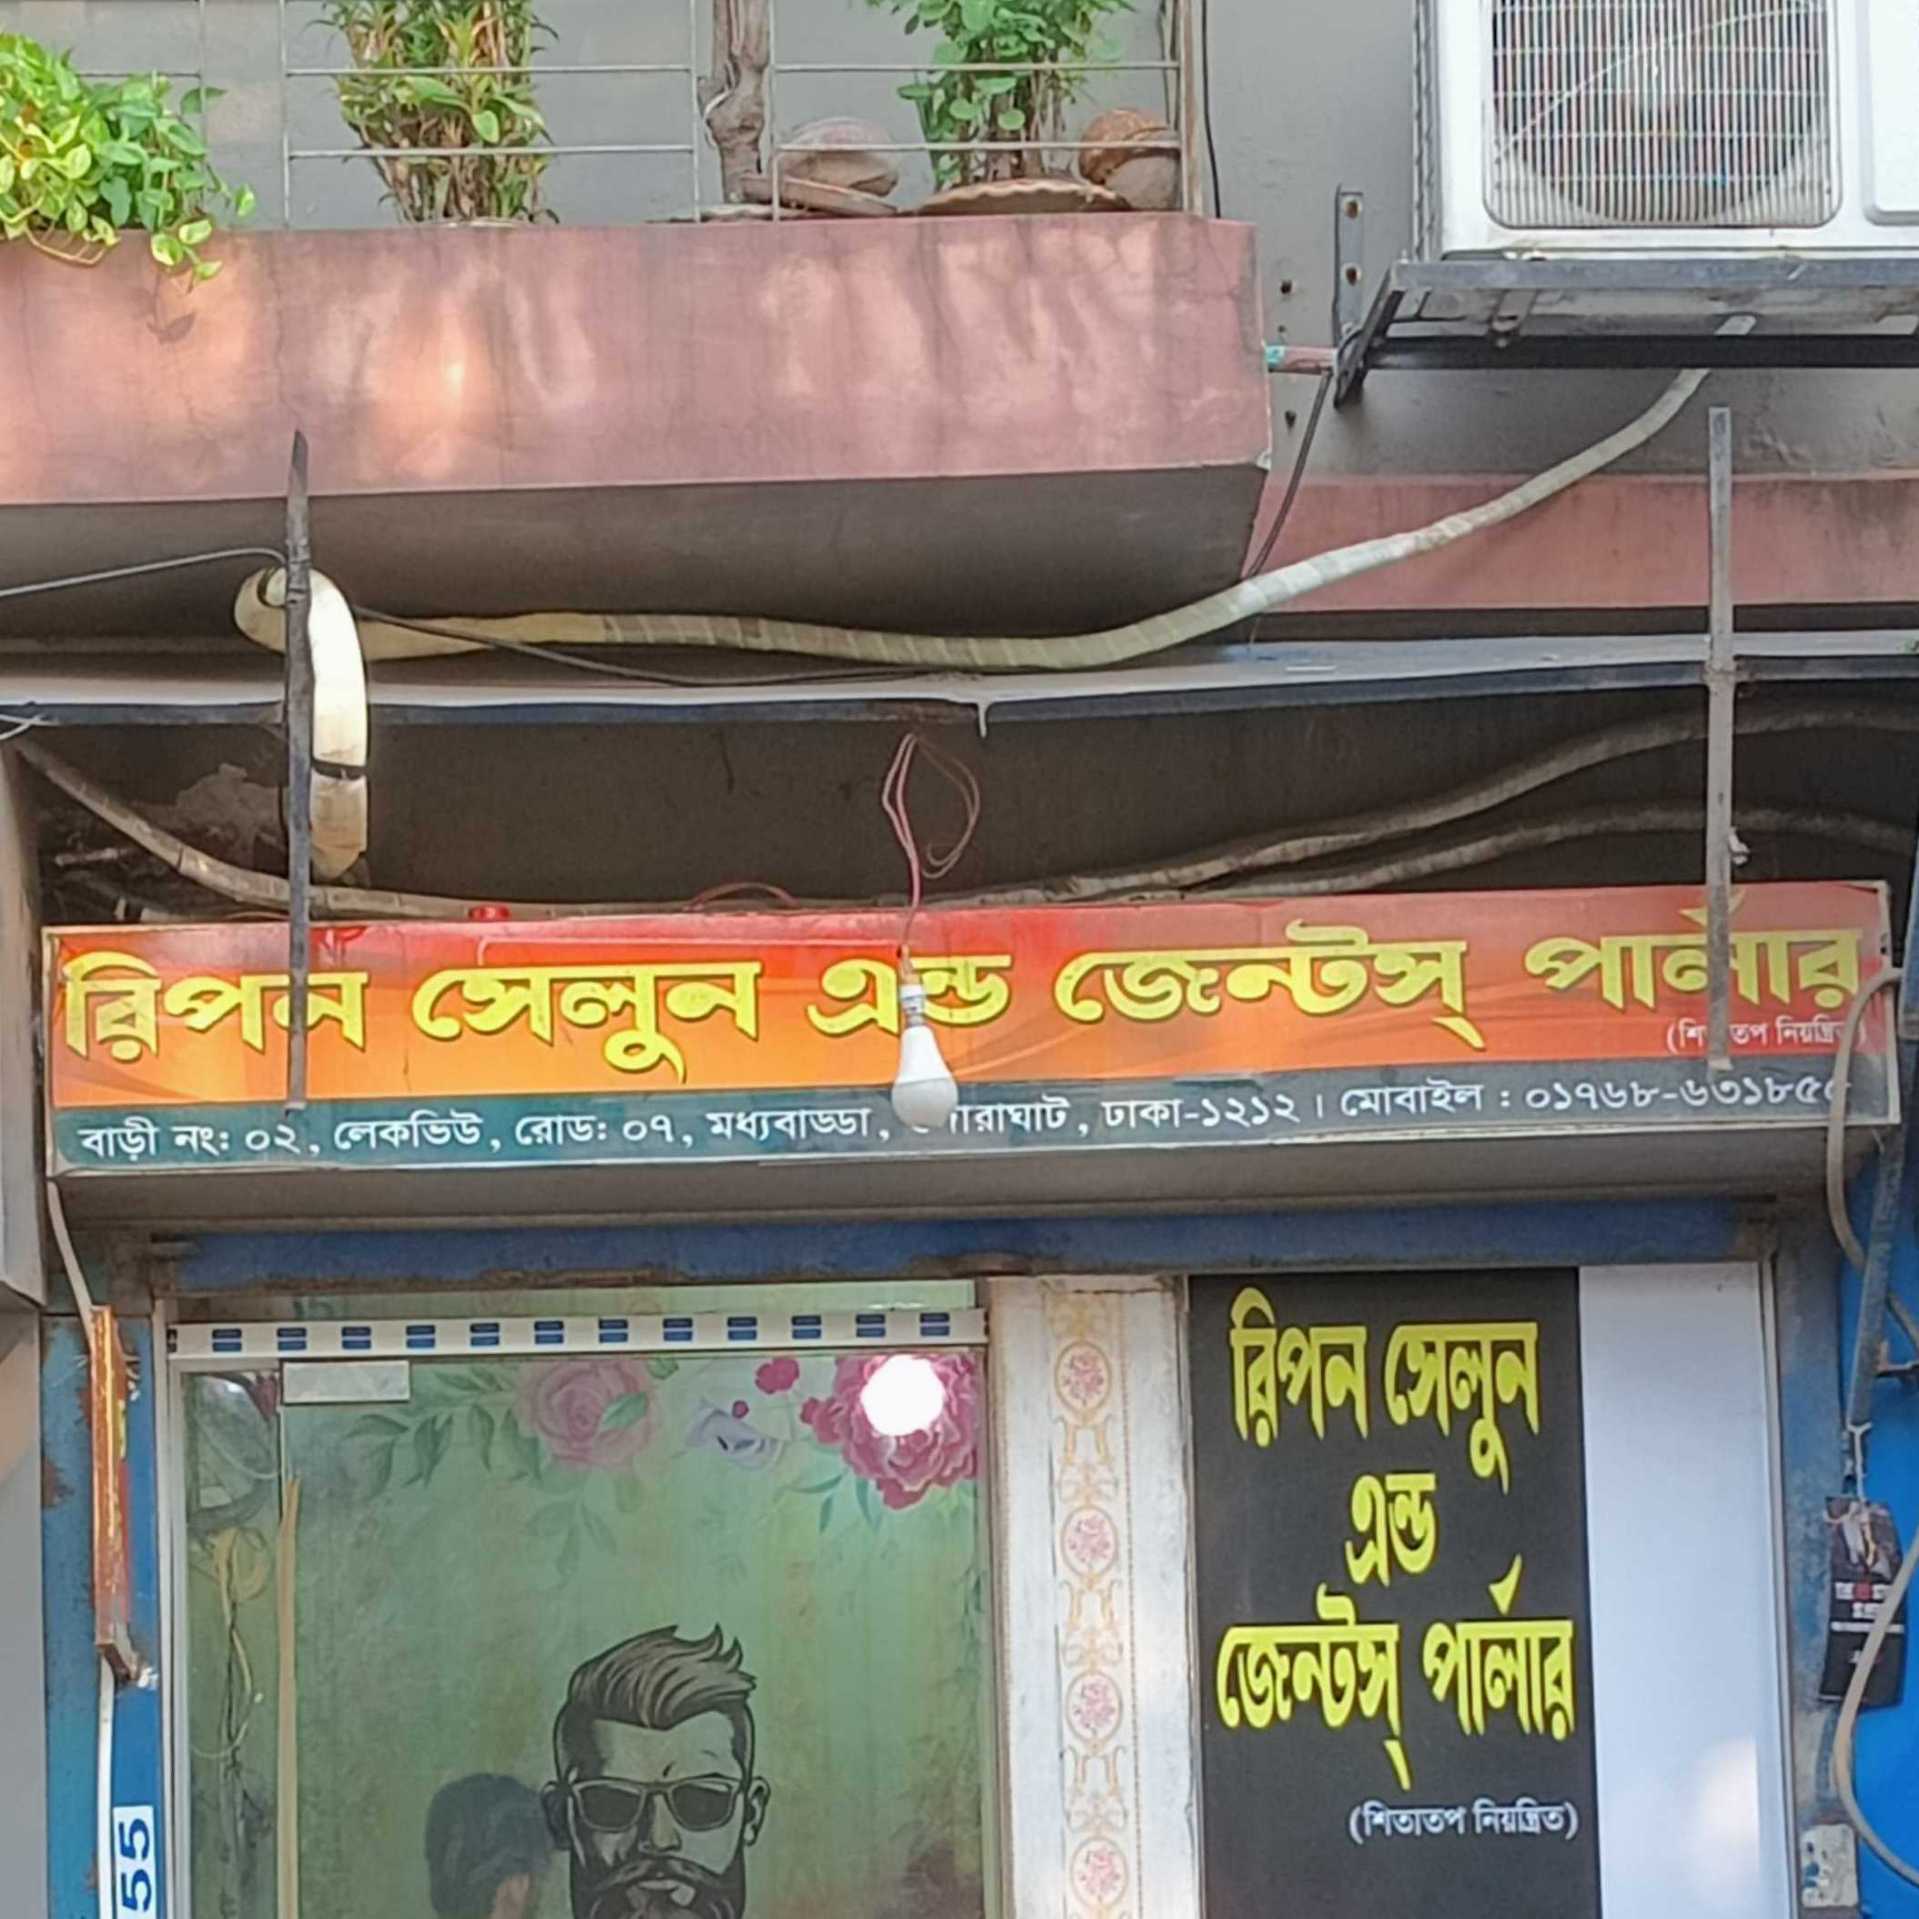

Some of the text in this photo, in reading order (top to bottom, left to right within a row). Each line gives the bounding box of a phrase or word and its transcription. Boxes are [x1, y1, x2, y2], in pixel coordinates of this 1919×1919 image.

[63, 950, 371, 1064] রিপন
[411, 961, 763, 1083] সেলুন
[806, 955, 1013, 1037] এন্ড
[1054, 919, 1486, 1051] জেন্টস্
[77, 1115, 160, 1161] বাড়ী
[1100, 1093, 1301, 1129] ঢাকা-১২১২
[1340, 1077, 1485, 1117] মোবাইল
[1229, 1286, 1540, 1496] রিপন সেলুন
[1344, 1472, 1438, 1588] এন্ড
[1215, 1553, 1576, 1792] জেন্টস্ পার্লার
